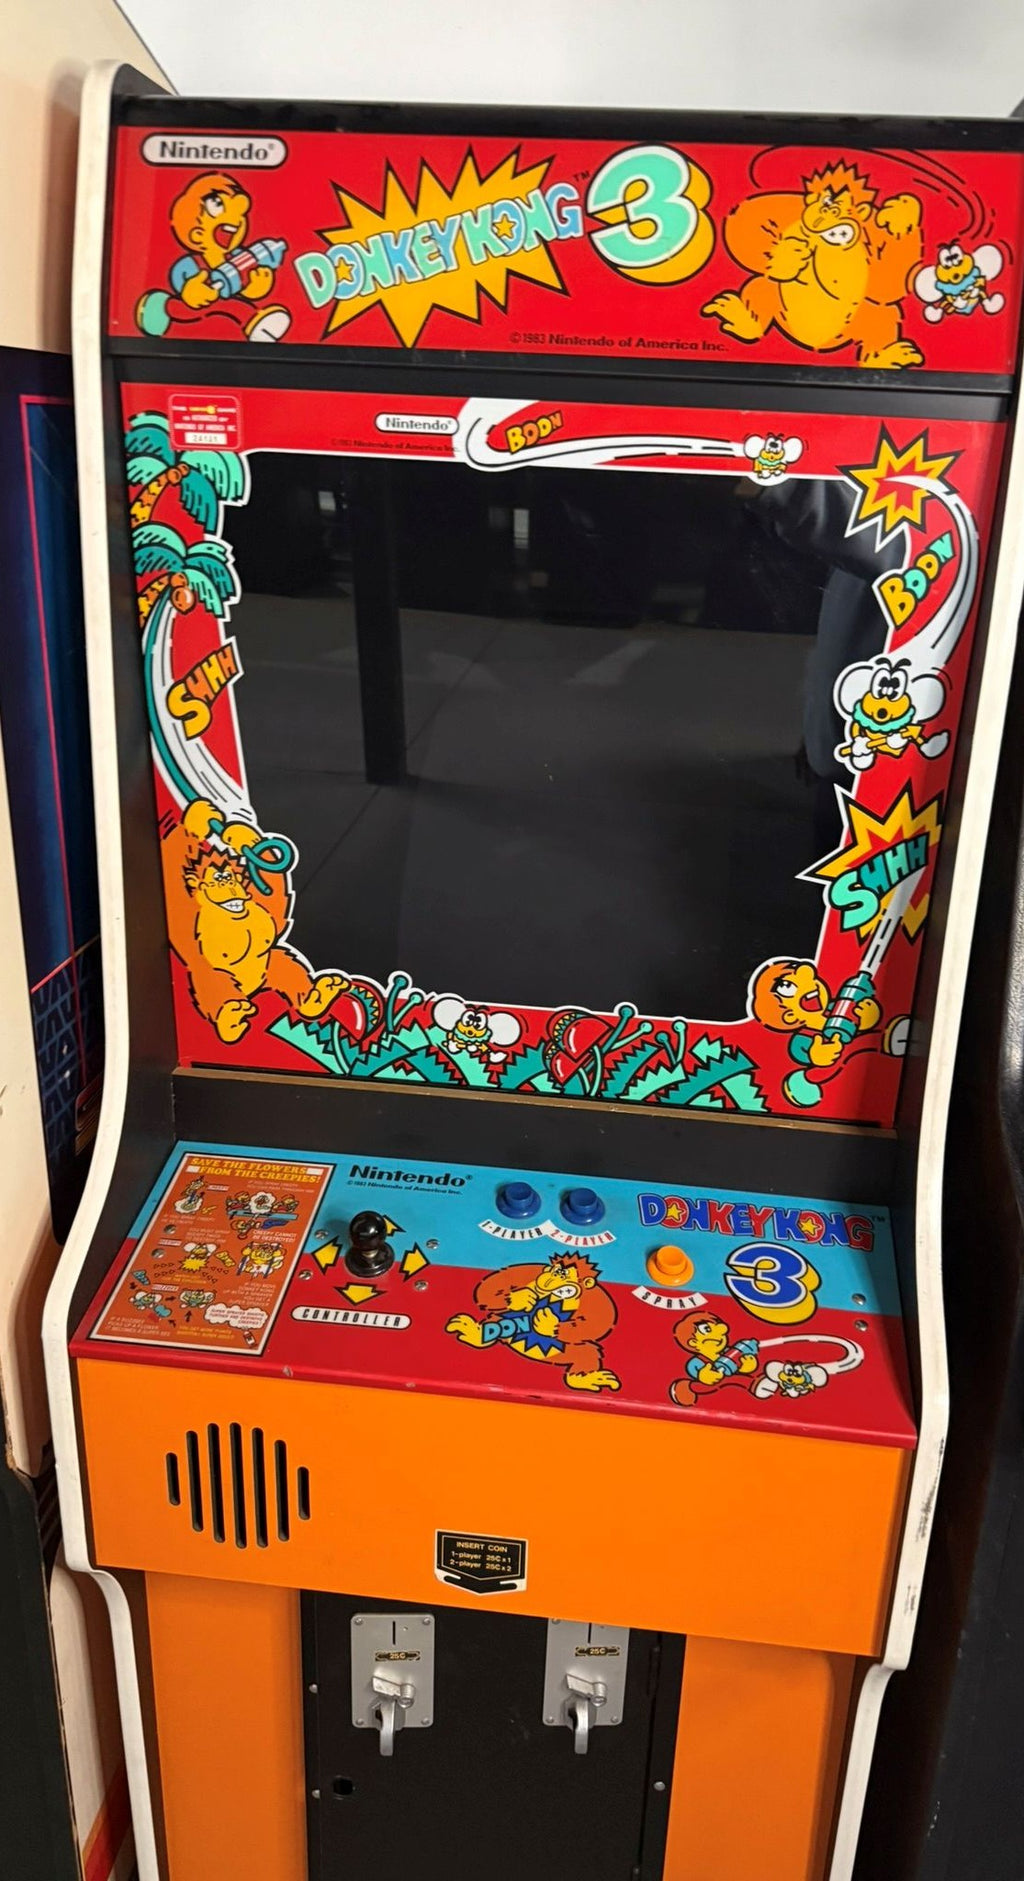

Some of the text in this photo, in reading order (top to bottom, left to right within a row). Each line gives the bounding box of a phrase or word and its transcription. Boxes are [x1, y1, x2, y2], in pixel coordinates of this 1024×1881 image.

[293, 213, 460, 309] DONKEY
[459, 182, 585, 265] KONG
[586, 142, 716, 287] 3
[549, 333, 615, 348] Nintendo
[618, 336, 633, 348] of
[635, 337, 700, 351] America
[702, 340, 730, 352] Inc.
[506, 410, 564, 455] BOON
[877, 529, 957, 632] BOON
[166, 642, 241, 742] SHHH
[828, 831, 930, 932] SHHH
[190, 1157, 307, 1174] SAVE THE FLOWERS
[199, 1165, 321, 1183] FROM THE CREEPIES!
[367, 1181, 403, 1190] Nintendo
[413, 1186, 447, 1194] America
[481, 1220, 543, 1240] 1-PLAYER
[637, 1192, 774, 1237] DONKEY
[773, 1205, 875, 1252] KONG
[550, 1229, 614, 1246] 2-PLAYER
[723, 1241, 822, 1326] 3
[641, 1291, 698, 1308] SPRAY
[302, 1308, 401, 1327] CONTROLLER
[481, 1315, 533, 1345] DON
[451, 1550, 482, 1560] 1-player
[456, 1541, 508, 1553] INSERT COIN
[449, 1559, 482, 1568] 2-player
